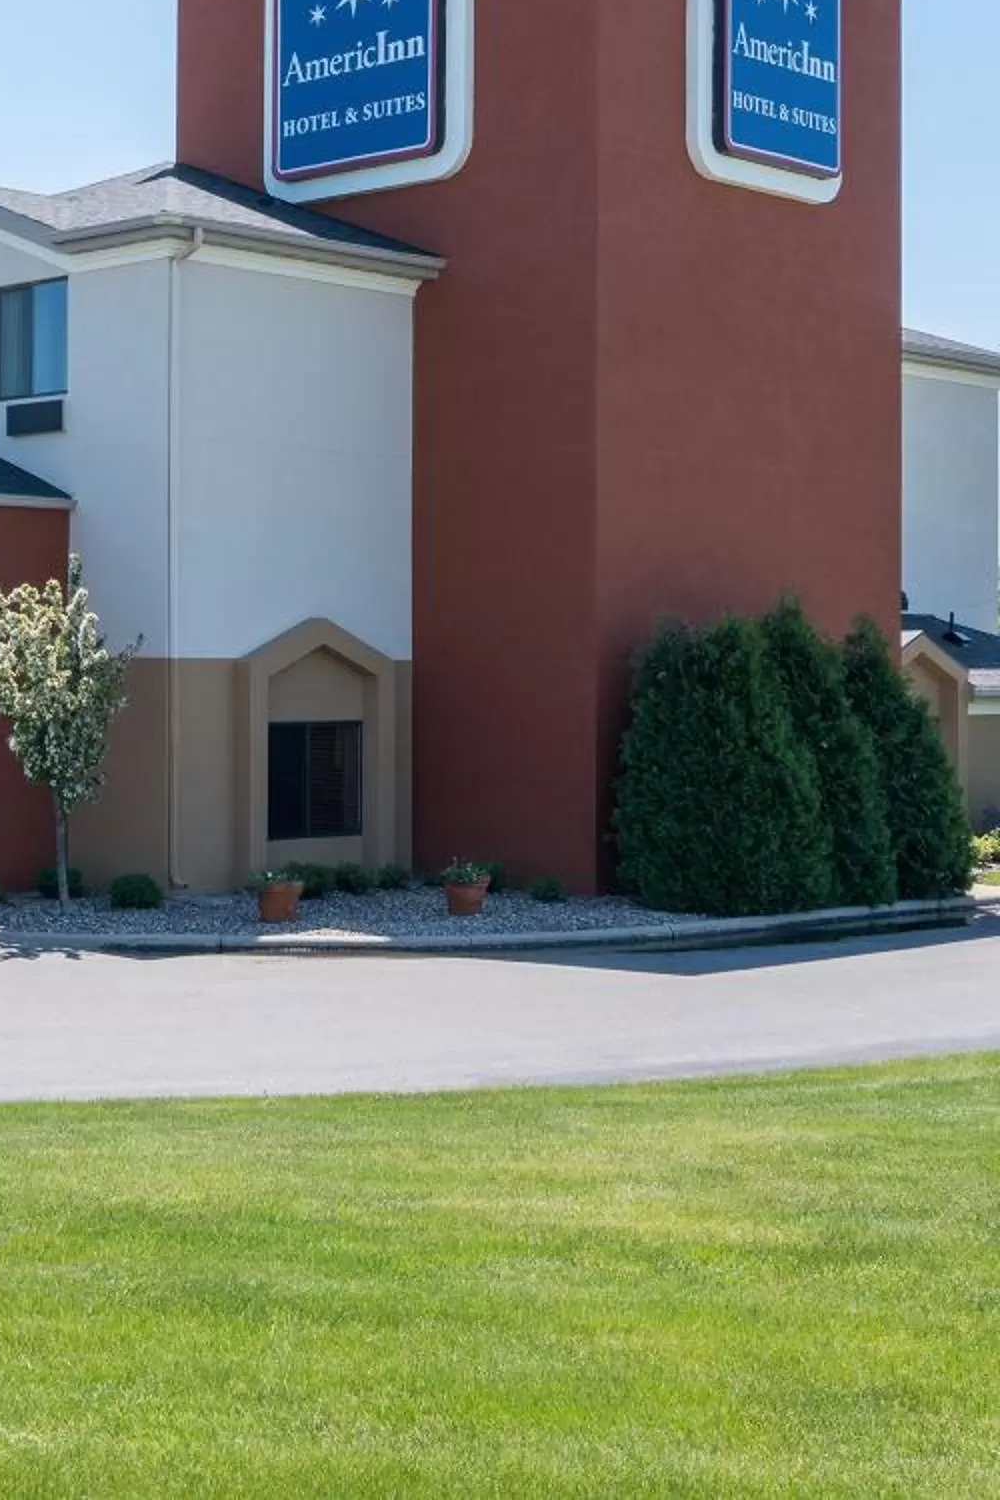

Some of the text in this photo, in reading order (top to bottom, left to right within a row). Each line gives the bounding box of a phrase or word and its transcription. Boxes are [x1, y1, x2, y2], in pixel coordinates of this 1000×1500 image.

[283, 29, 425, 86] AmericInn
[732, 21, 836, 83] AmericInn
[283, 92, 425, 137] HOTEL & SUITES
[733, 91, 837, 135] HOTEL & SUITES
